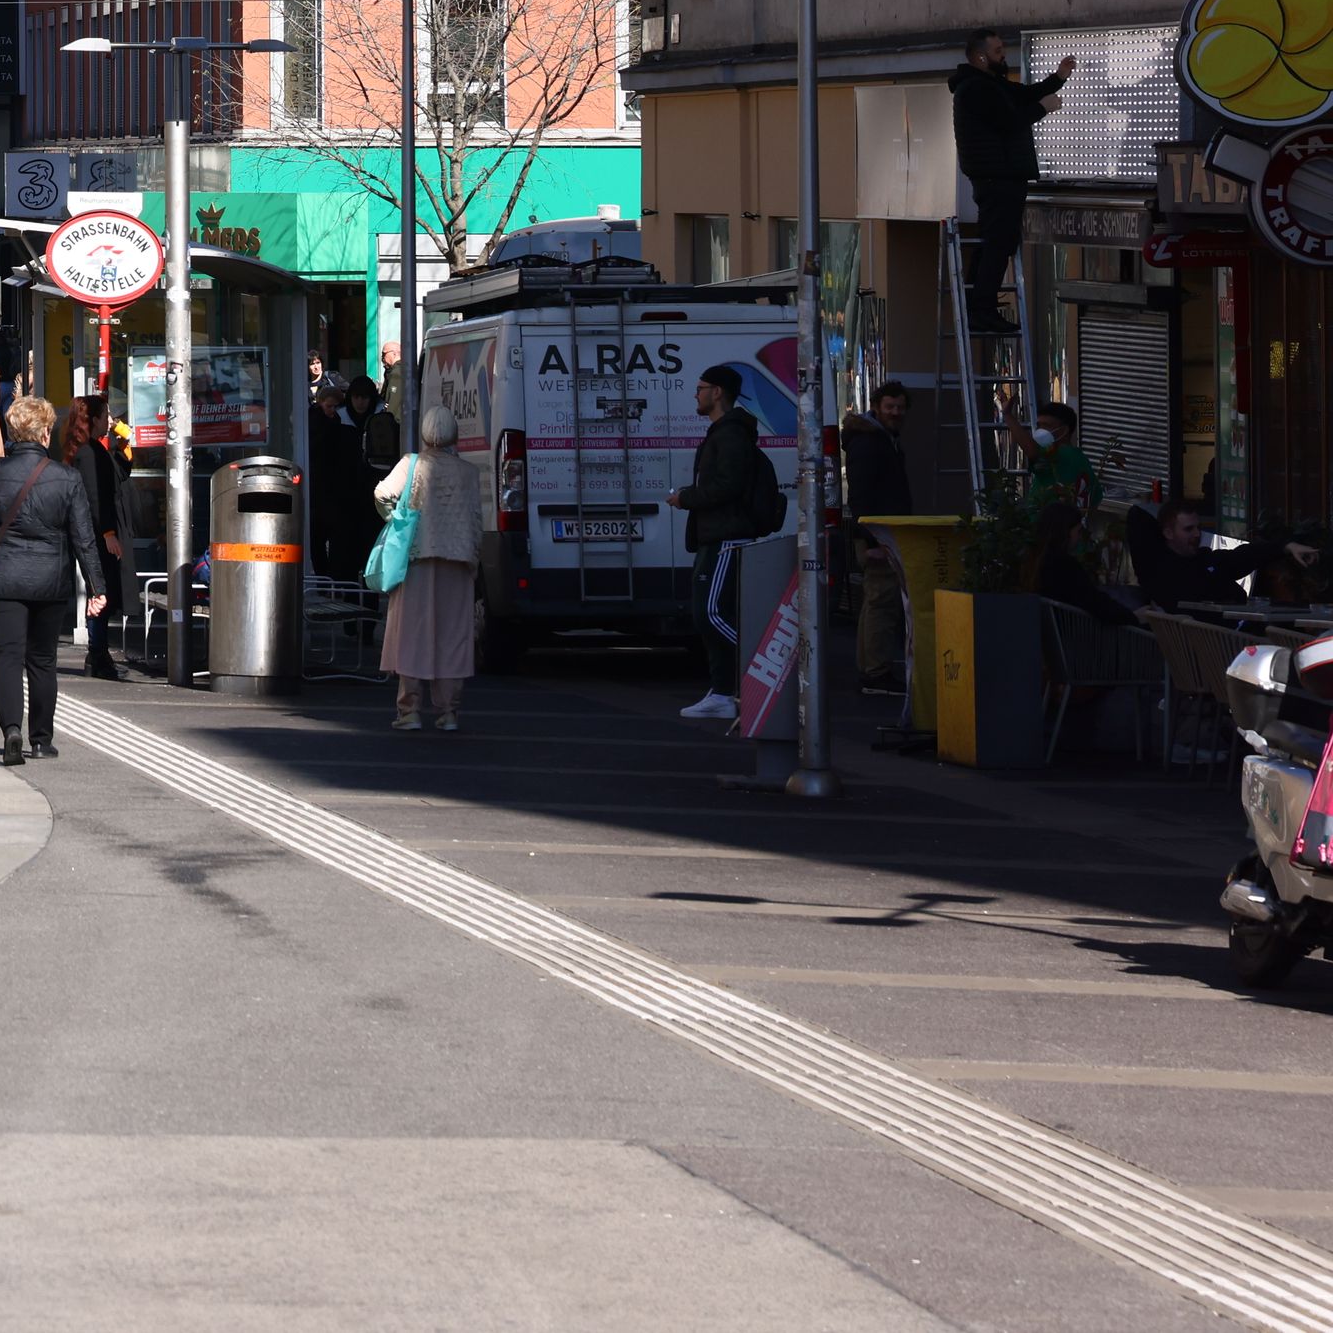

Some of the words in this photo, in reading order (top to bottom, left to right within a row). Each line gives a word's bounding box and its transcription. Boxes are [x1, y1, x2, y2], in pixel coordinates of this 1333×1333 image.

[60, 222, 150, 254] STRASSENBAHN
[64, 267, 146, 293] HALTESTELLE
[538, 343, 683, 375] ALRAS
[538, 379, 684, 392] WERBEAGENTUR
[454, 389, 477, 420] ALRAS
[589, 423, 614, 434] and
[531, 466, 546, 475] Tel
[531, 480, 558, 490] Mobil
[588, 480, 609, 490] 699
[645, 480, 665, 489] 555
